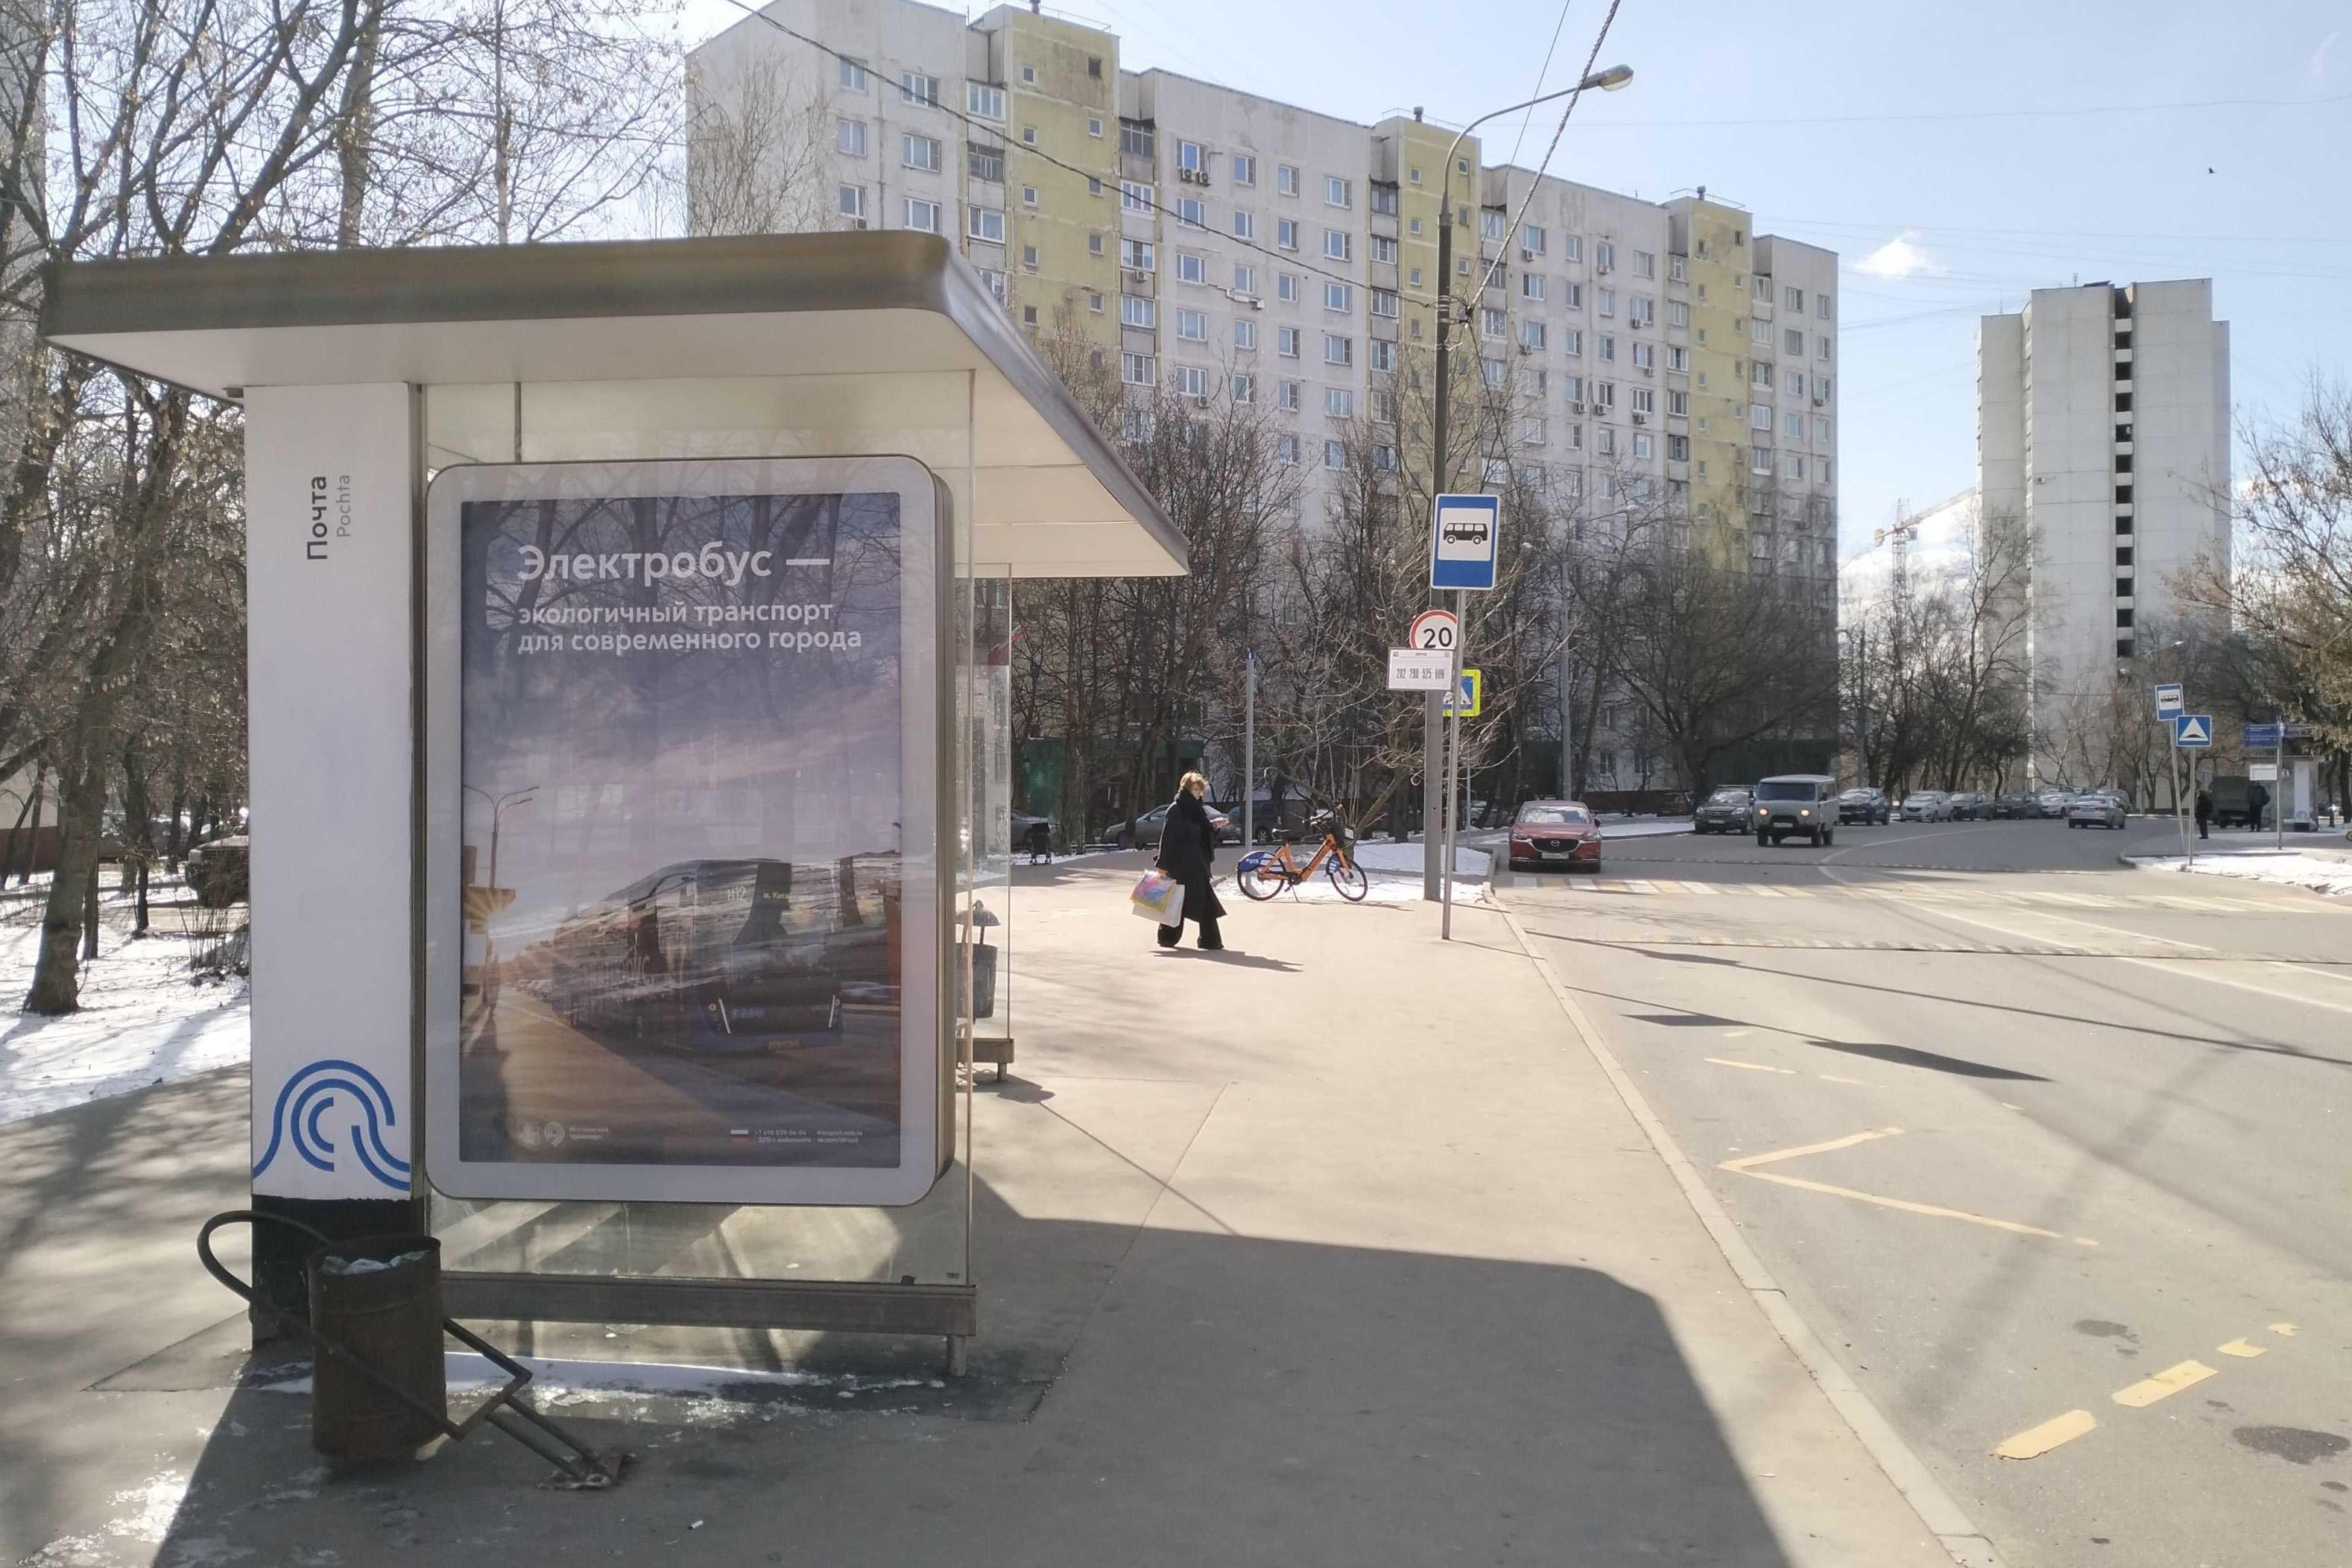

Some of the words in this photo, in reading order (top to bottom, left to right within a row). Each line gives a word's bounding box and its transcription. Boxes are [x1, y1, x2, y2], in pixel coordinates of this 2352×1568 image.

[306, 476, 328, 560] Почта
[335, 475, 351, 537] Pochta
[517, 541, 772, 587] Электробус
[518, 600, 686, 625] экологичный
[694, 601, 832, 627] транспорт
[518, 631, 563, 655] для
[572, 630, 761, 657] современного
[769, 628, 862, 654] города
[1423, 627, 1452, 648] 20
